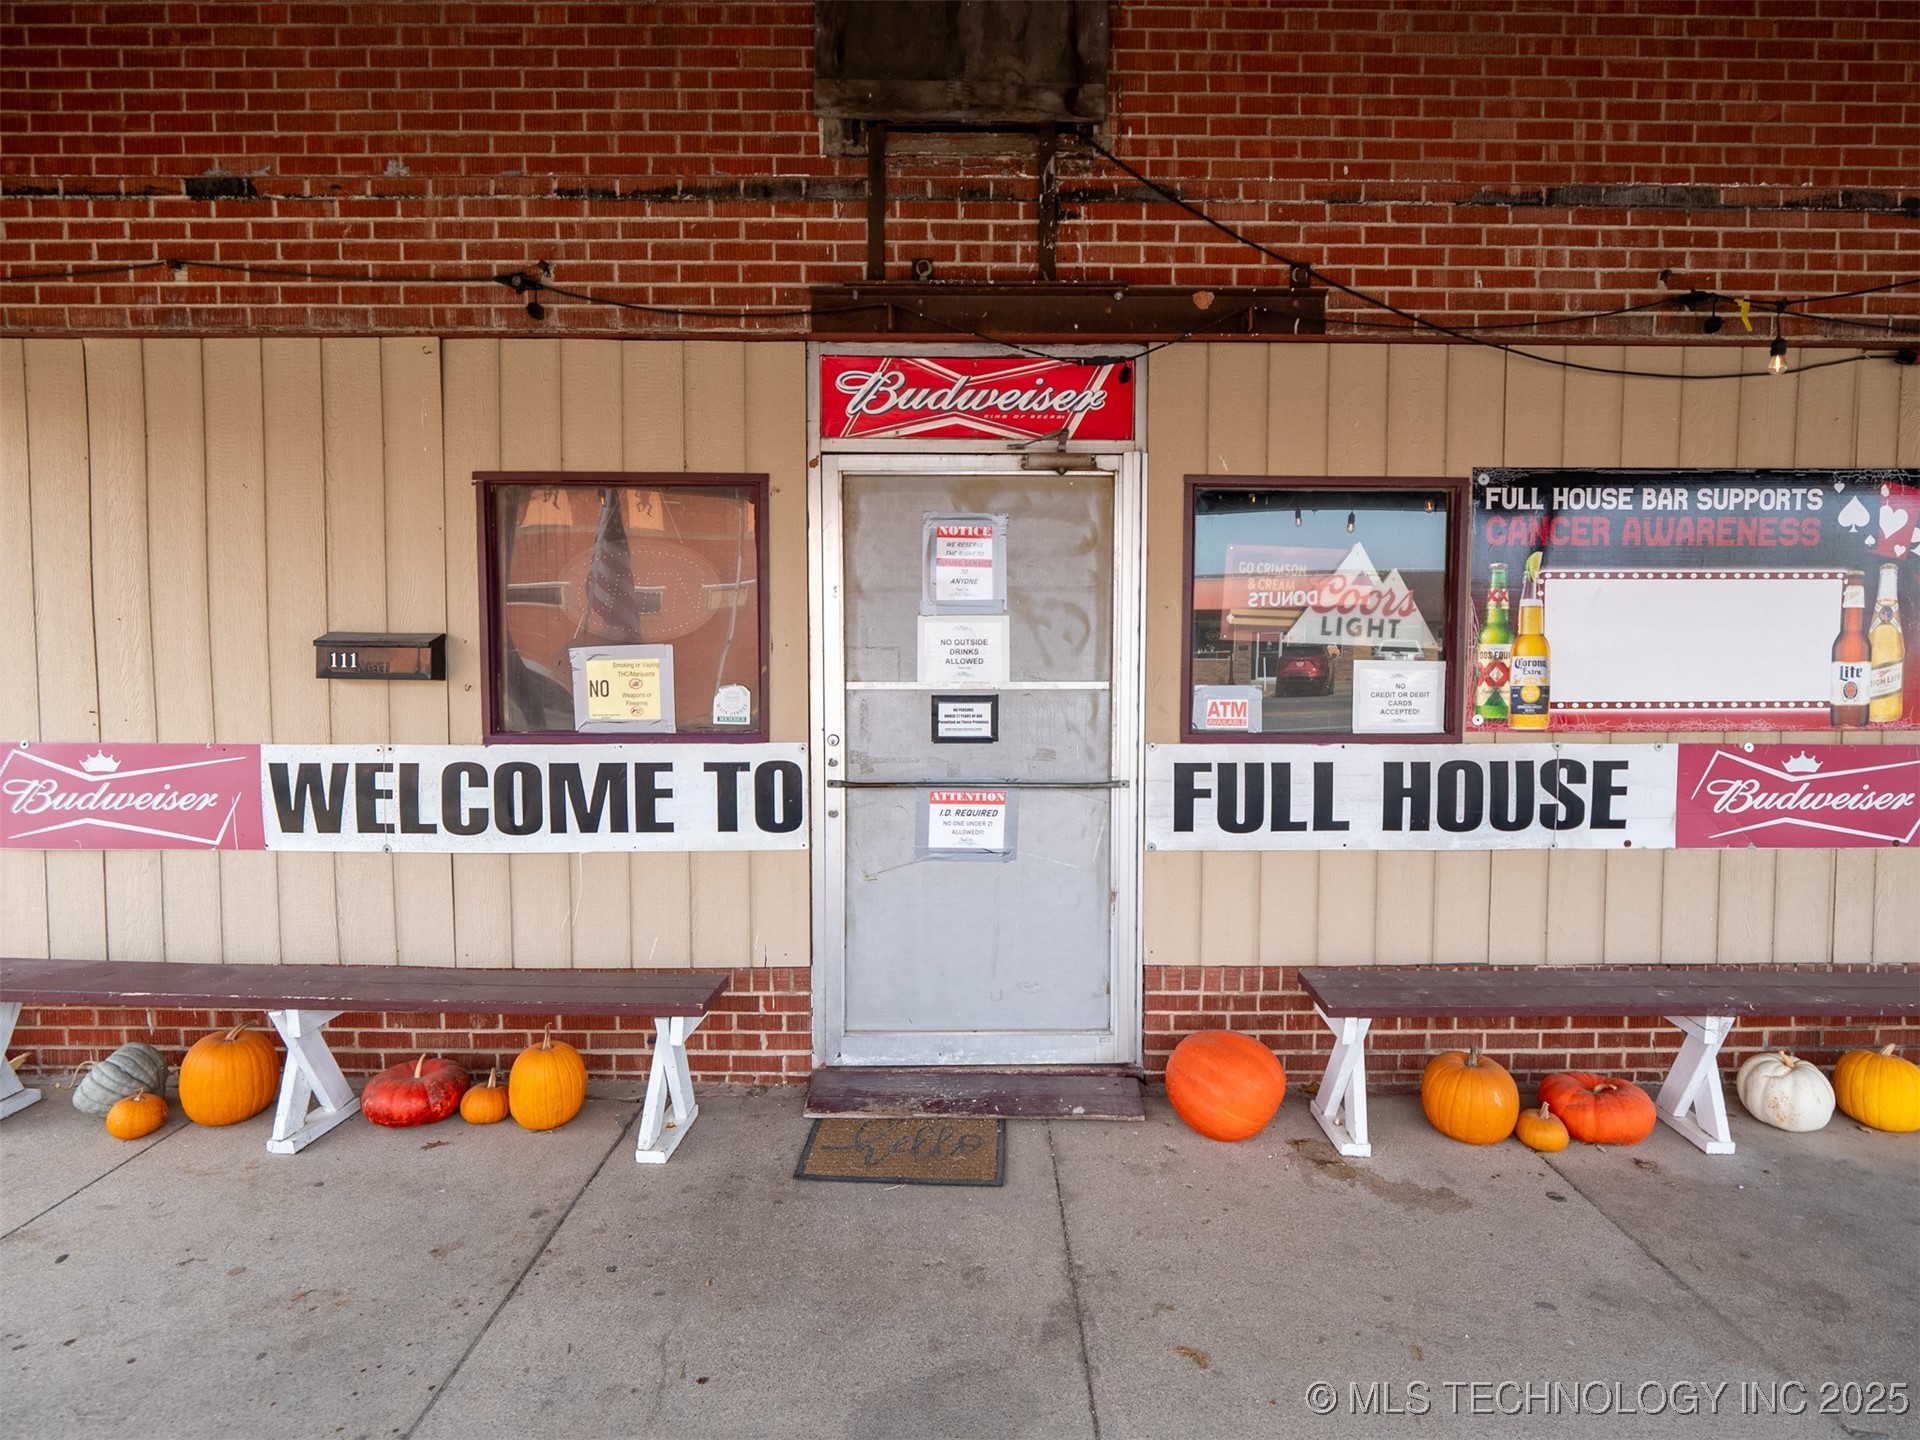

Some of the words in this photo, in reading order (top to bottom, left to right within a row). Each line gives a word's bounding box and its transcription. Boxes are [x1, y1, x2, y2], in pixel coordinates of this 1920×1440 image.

[835, 370, 1106, 417] Budweiser
[1485, 487, 1544, 510] FULL
[1553, 487, 1634, 510] HOUSE
[1642, 488, 1688, 510] BAR
[1697, 488, 1823, 511] SUPPORTS
[938, 526, 992, 536] NOTICE
[1485, 515, 1610, 546] CANCER
[1622, 516, 1821, 547] AWARENESS
[1239, 562, 1254, 574] GO
[1256, 563, 1307, 576] CRIMSON
[1247, 578, 1256, 590] &
[1258, 578, 1295, 591] CREAM
[1310, 574, 1417, 617] Coors
[1321, 616, 1401, 638] LIGHT
[330, 652, 357, 668] 111
[1494, 651, 1511, 660] EQUI
[1514, 658, 1548, 669] Corona
[1839, 665, 1862, 681] Lite
[589, 679, 609, 698] NO
[1207, 701, 1247, 717] ATM
[2, 778, 219, 816] Budweiser
[269, 761, 674, 835] WELCOME
[703, 761, 802, 834] TO
[931, 791, 1005, 801] ATTENTION
[1173, 761, 1350, 833] FULL
[1382, 759, 1628, 832] HOUSE
[1706, 778, 1915, 813] Budweiser
[954, 809, 998, 817] REQUIRED
